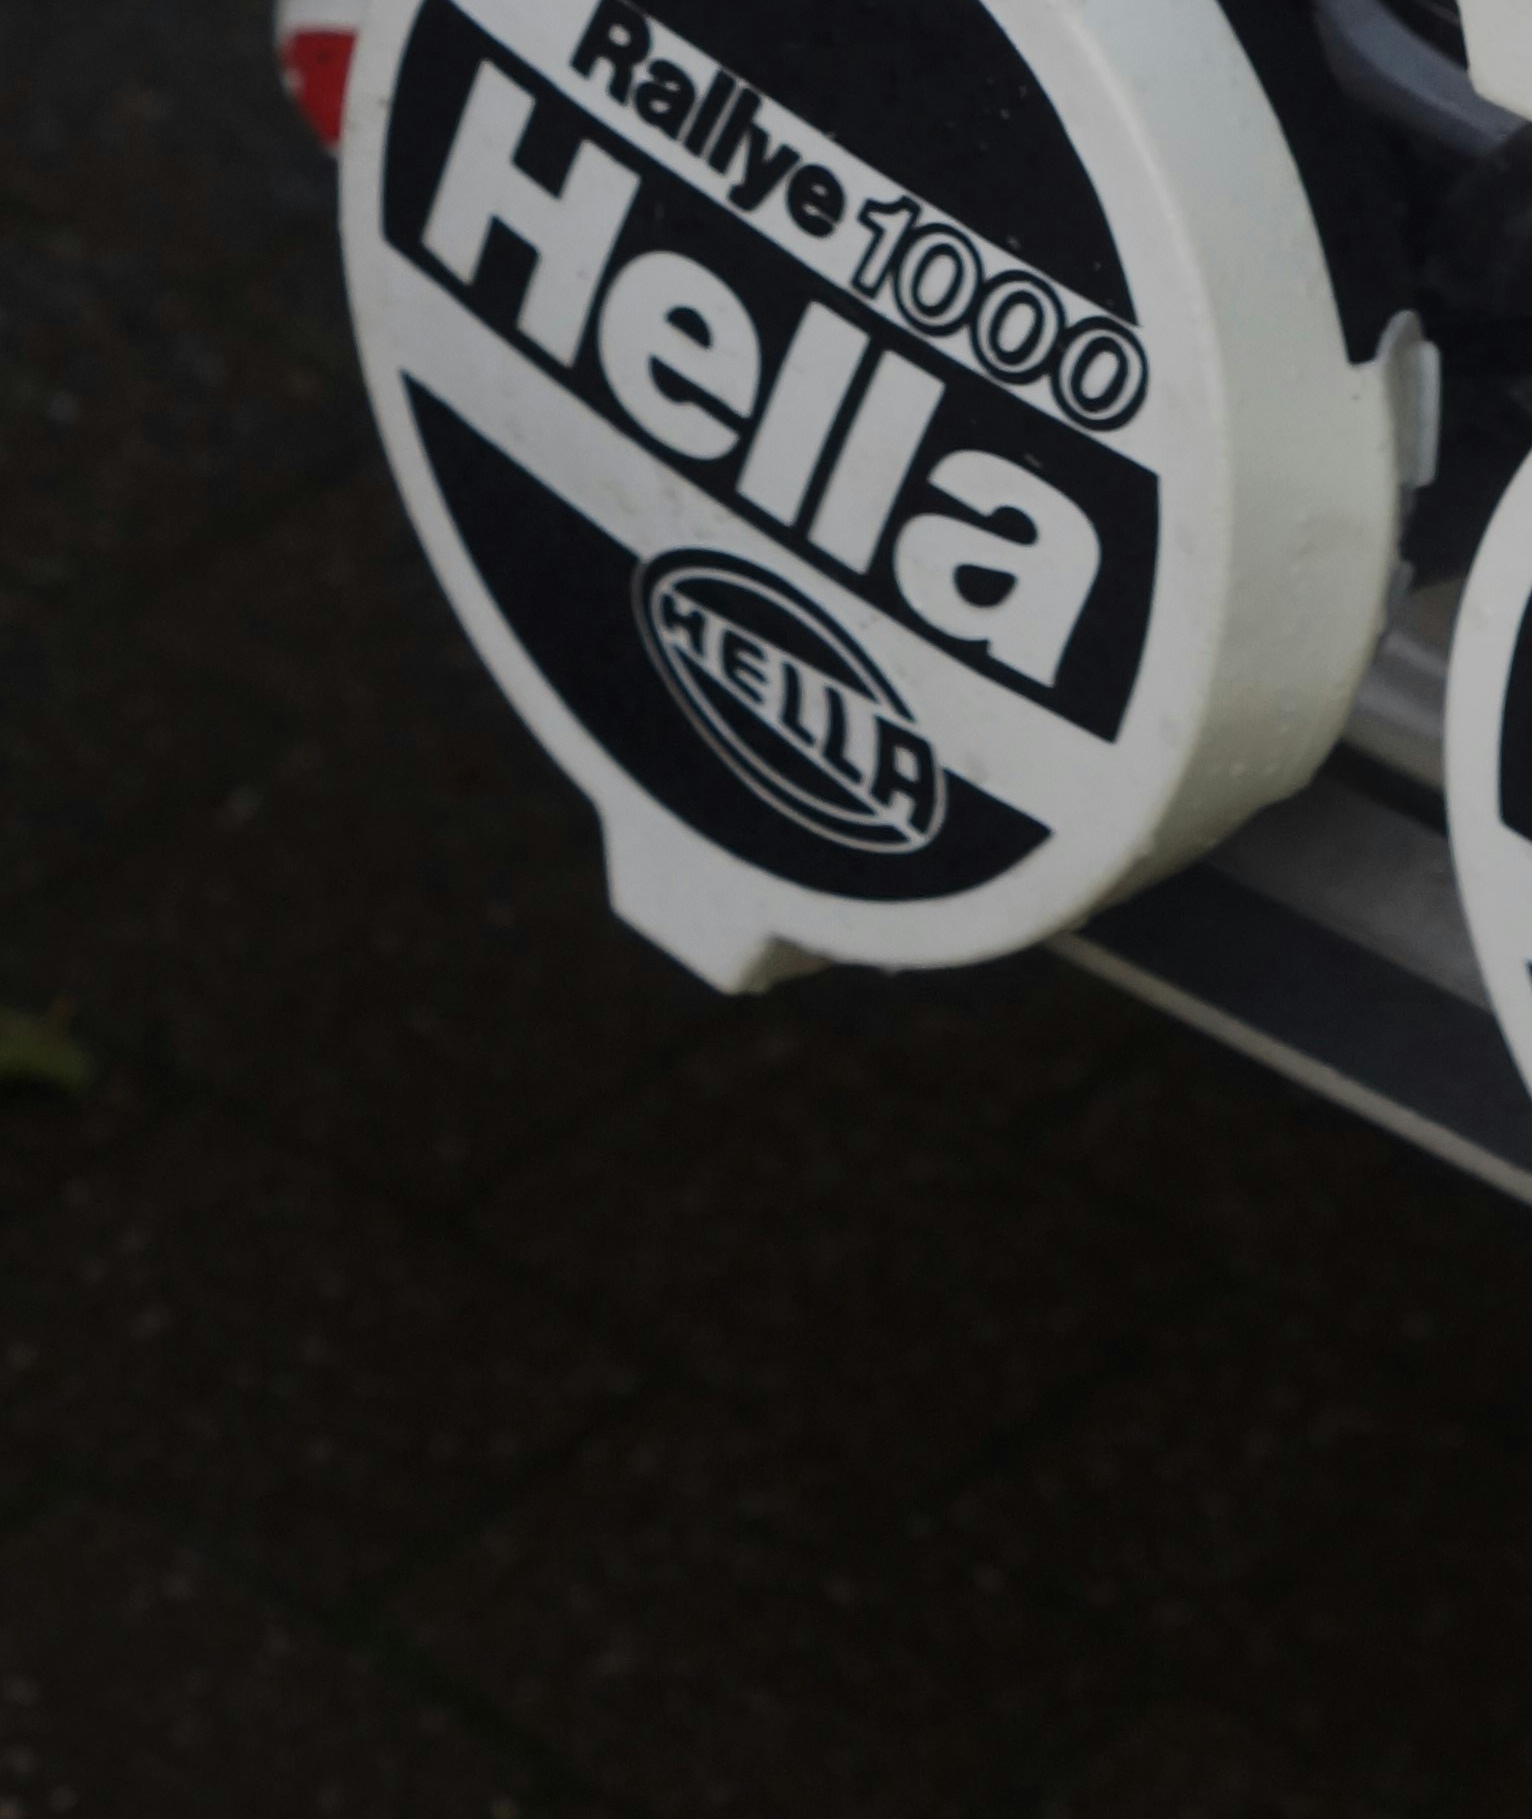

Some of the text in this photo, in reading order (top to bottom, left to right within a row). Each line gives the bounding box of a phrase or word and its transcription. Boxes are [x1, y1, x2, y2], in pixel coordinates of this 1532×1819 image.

[420, 59, 1102, 688] Hella
[852, 193, 1149, 435] 1000
[659, 599, 936, 841] HELLA
